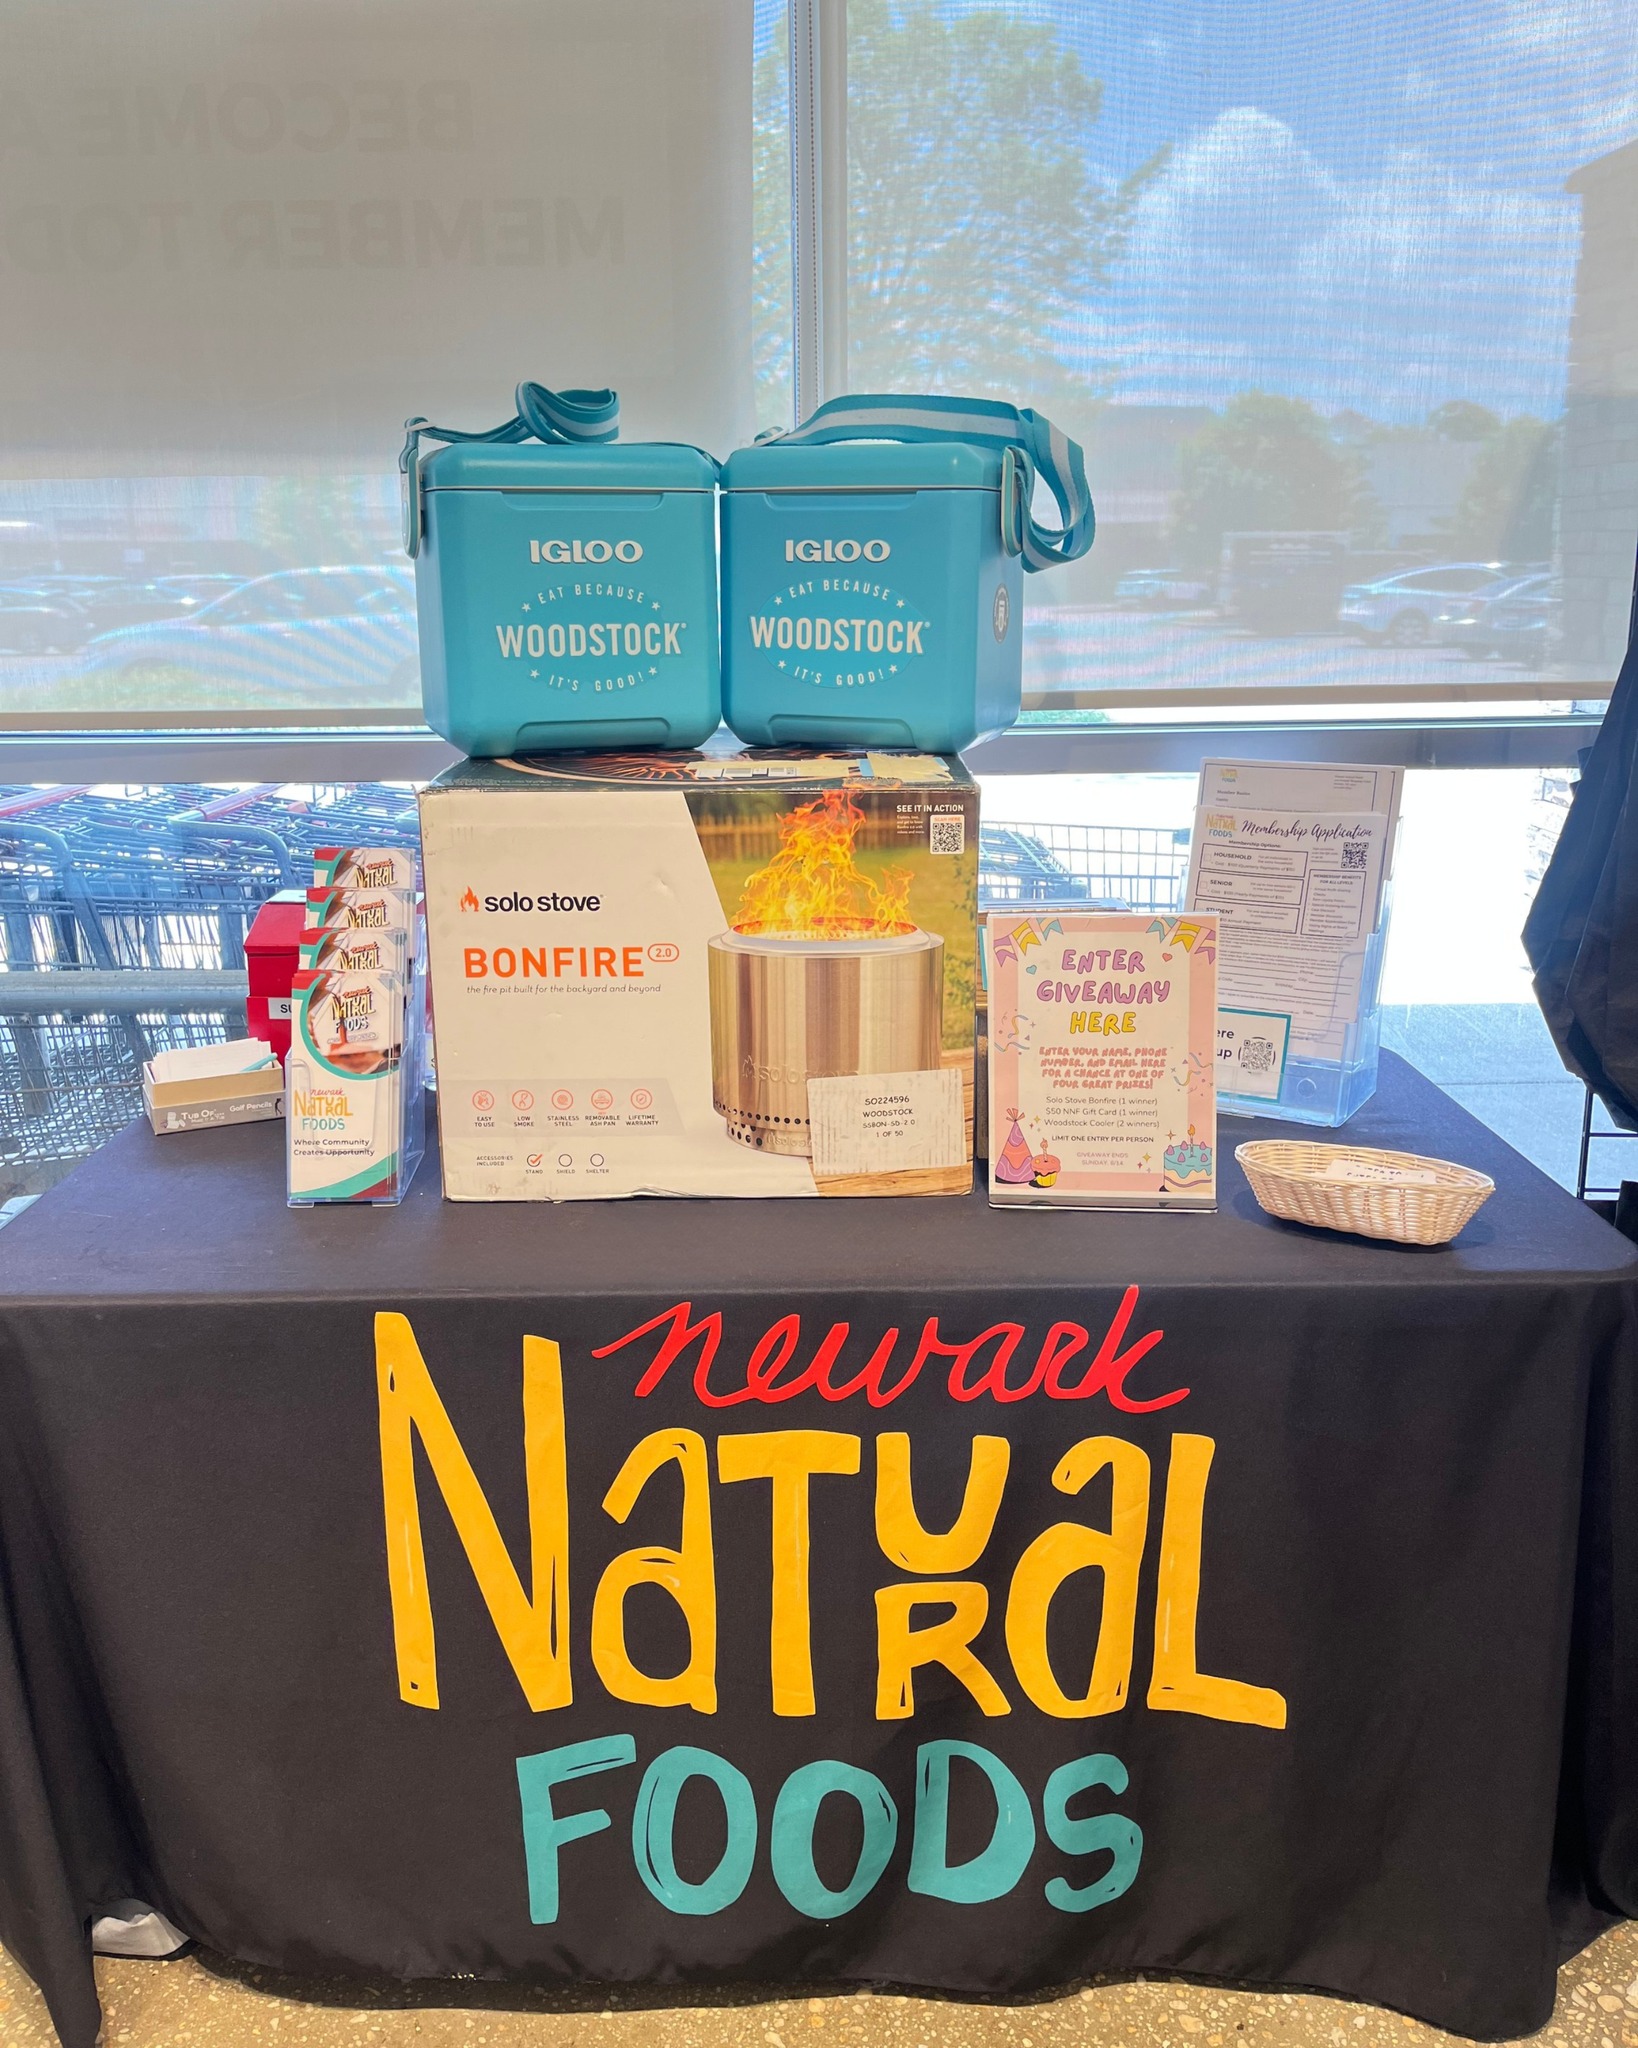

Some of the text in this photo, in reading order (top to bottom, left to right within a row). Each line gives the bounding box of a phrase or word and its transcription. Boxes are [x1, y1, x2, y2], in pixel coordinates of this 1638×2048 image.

[529, 540, 644, 564] IGLOO
[785, 539, 891, 563] IGLOO
[538, 583, 644, 604] EAT BECAUSE
[789, 579, 890, 600] EAT BECAUSE
[549, 671, 644, 692] IT'S GOOD!
[794, 666, 884, 685] IT'S GOOD!
[896, 804, 964, 813] SEE IT IN ACTION
[1242, 820, 1373, 842] Membership Application
[1214, 852, 1252, 860] HOUSEHOLD
[1210, 879, 1233, 887] SENIOR
[485, 891, 601, 912] solo stove
[464, 947, 672, 978] BONFIRE 2.0
[1061, 949, 1146, 975] ENTER
[467, 984, 662, 995] the fire pit built for the backyard and beyond
[1036, 980, 1170, 1005] GIVEAWAY
[1069, 1011, 1137, 1036] HERE
[1039, 1046, 1070, 1057] ENTER
[1072, 1047, 1099, 1057] YOUR
[1134, 1047, 1168, 1057] PHONE
[1087, 1058, 1106, 1068] AND
[1108, 1058, 1138, 1068] EMAIL
[1140, 1058, 1167, 1068] HERE
[1042, 1068, 1165, 1079] FOR A CHANCE AT ONE OF
[1053, 1078, 1154, 1090] FOUR GREAT PRIZES!
[229, 1101, 273, 1113] Golf Pencils
[1046, 1096, 1158, 1106] Solo Stove Bonfire (1 winner)
[862, 1108, 914, 1118] WOODSTOCK
[1045, 1107, 1061, 1116] $50
[1082, 1108, 1097, 1116] Gift
[1098, 1108, 1117, 1116] Card
[1118, 1109, 1126, 1117] (1
[1129, 1109, 1158, 1117] winner)
[302, 1117, 346, 1131] FOODS
[1044, 1119, 1160, 1128] Woodstock Cooler (2 winners)
[322, 1139, 370, 1147] Community
[591, 1284, 1190, 1413] newark
[516, 1733, 1145, 1925] FOODS
